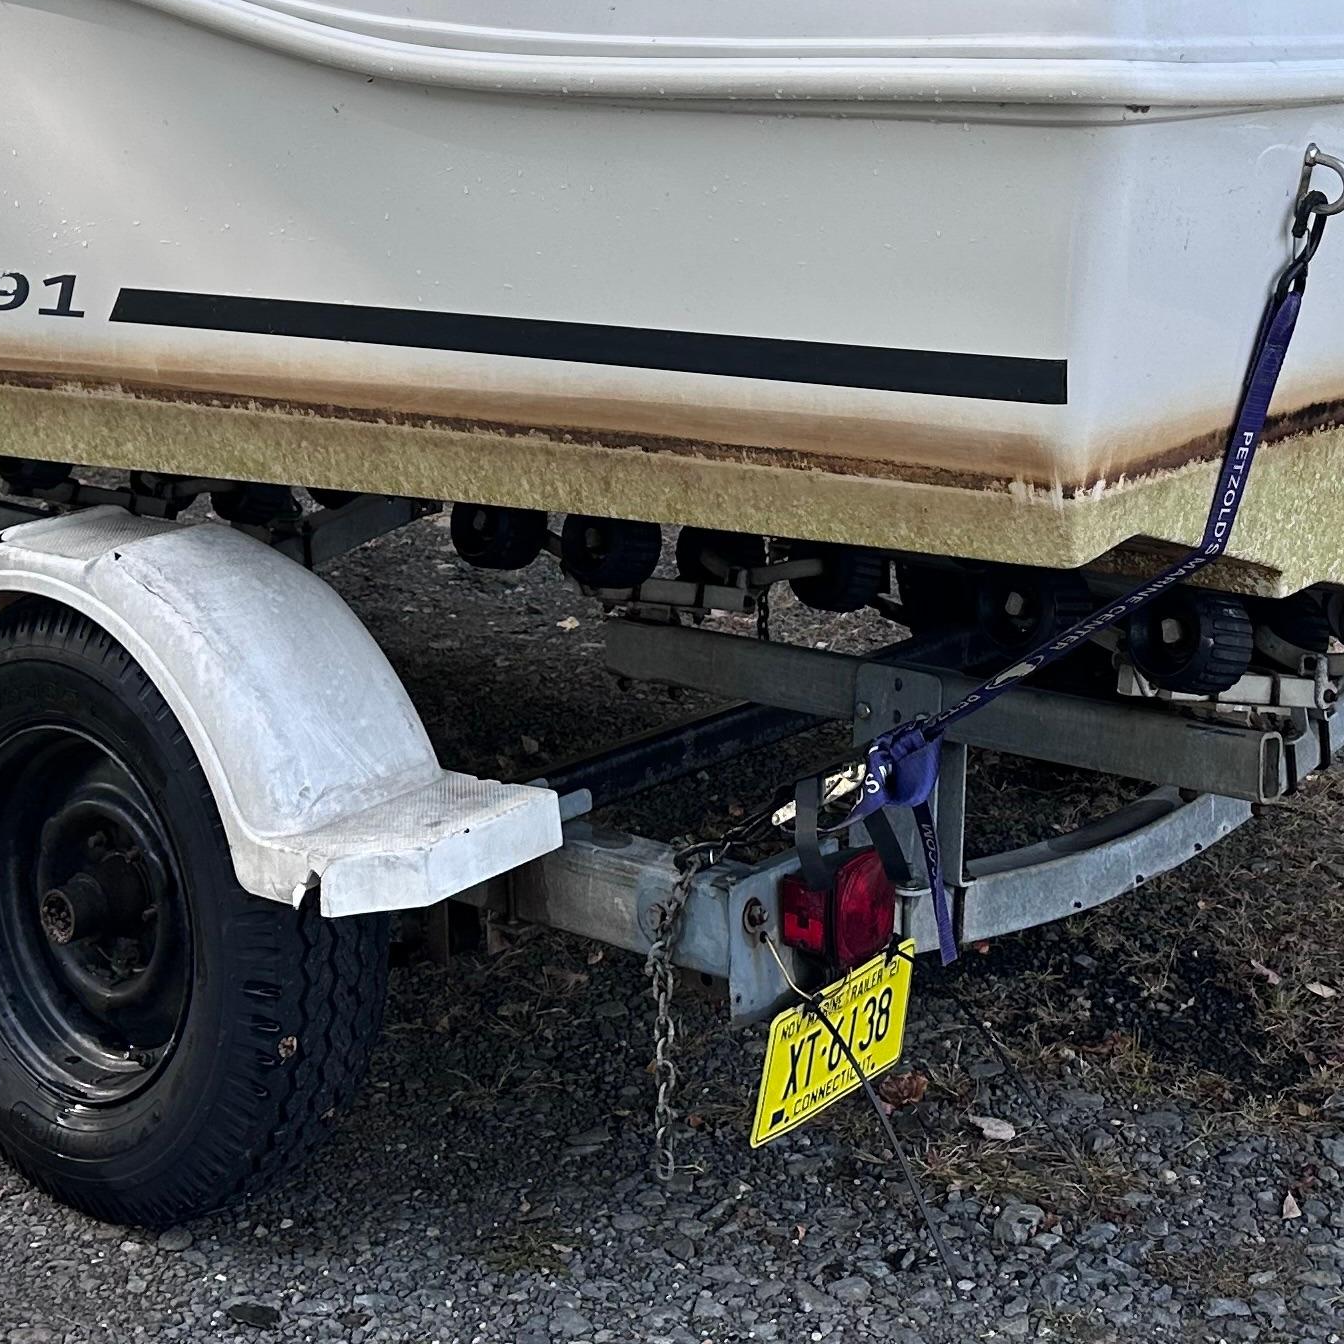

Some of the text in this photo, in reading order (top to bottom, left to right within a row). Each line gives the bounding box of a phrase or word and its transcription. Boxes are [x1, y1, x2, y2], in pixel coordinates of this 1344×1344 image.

[1049, 430, 1254, 651] PETZOLD'S MARINE CENTER
